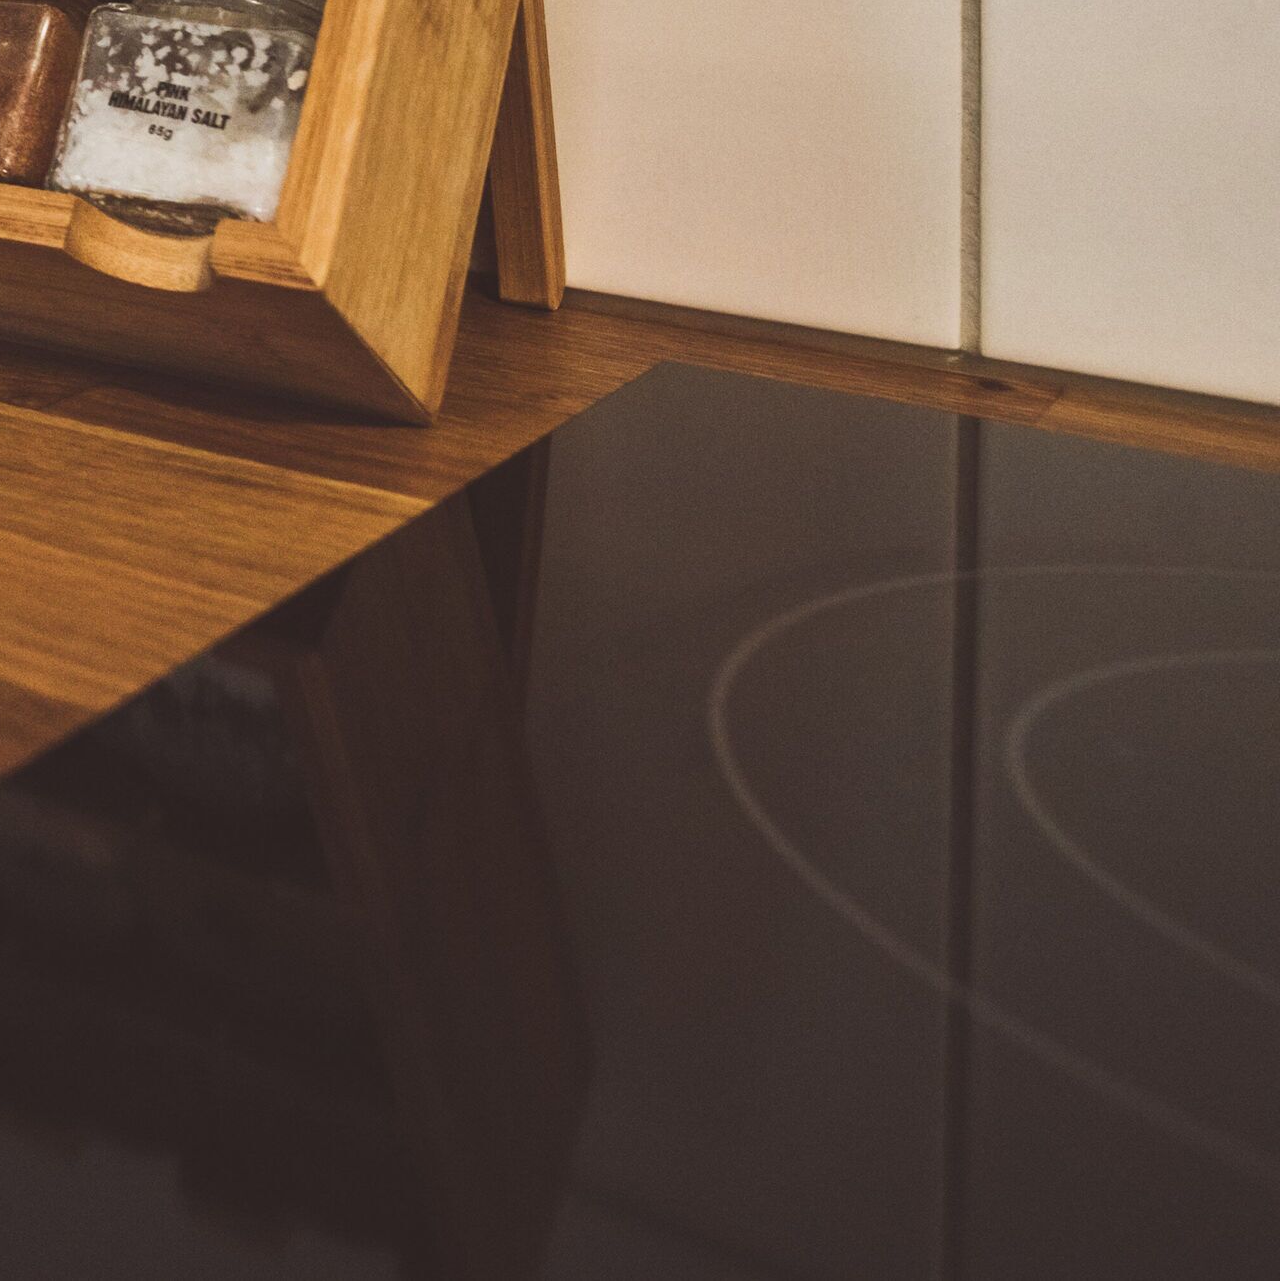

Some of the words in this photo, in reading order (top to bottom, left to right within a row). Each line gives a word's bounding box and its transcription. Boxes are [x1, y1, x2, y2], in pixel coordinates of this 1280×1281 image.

[155, 81, 191, 101] PINK
[107, 90, 189, 121] HIMALAYAN
[190, 108, 232, 130] SALT
